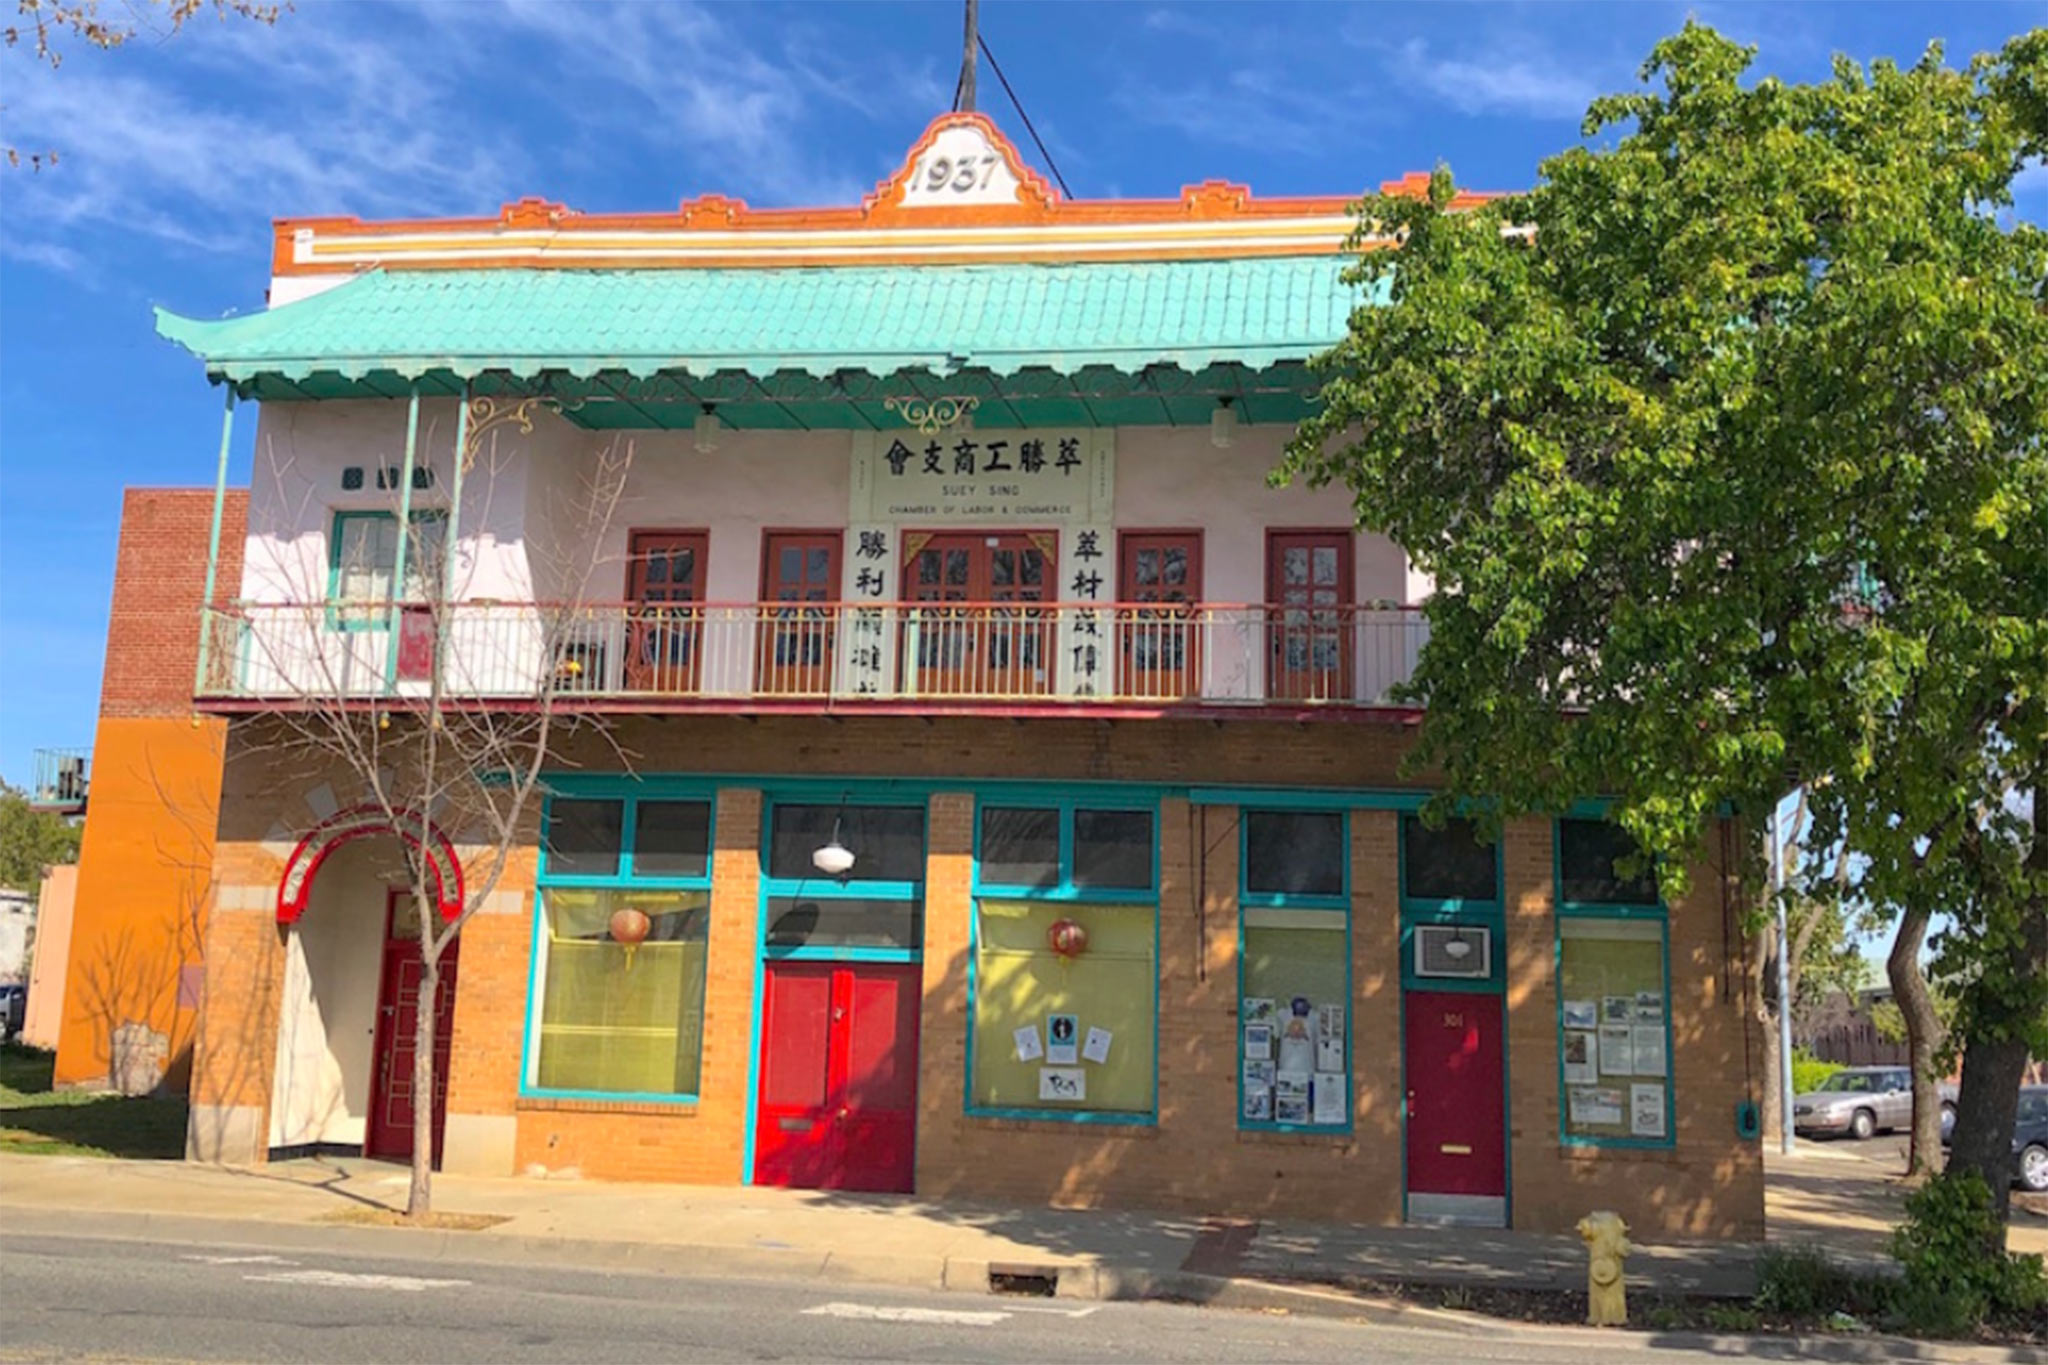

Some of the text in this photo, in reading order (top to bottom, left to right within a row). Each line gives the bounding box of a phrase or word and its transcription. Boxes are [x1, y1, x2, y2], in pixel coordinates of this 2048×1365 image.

[911, 154, 1001, 193] 1937
[942, 485, 1020, 496] SUEY SING
[889, 505, 1071, 514] CHAMBER OF LABOR & COMMERCE
